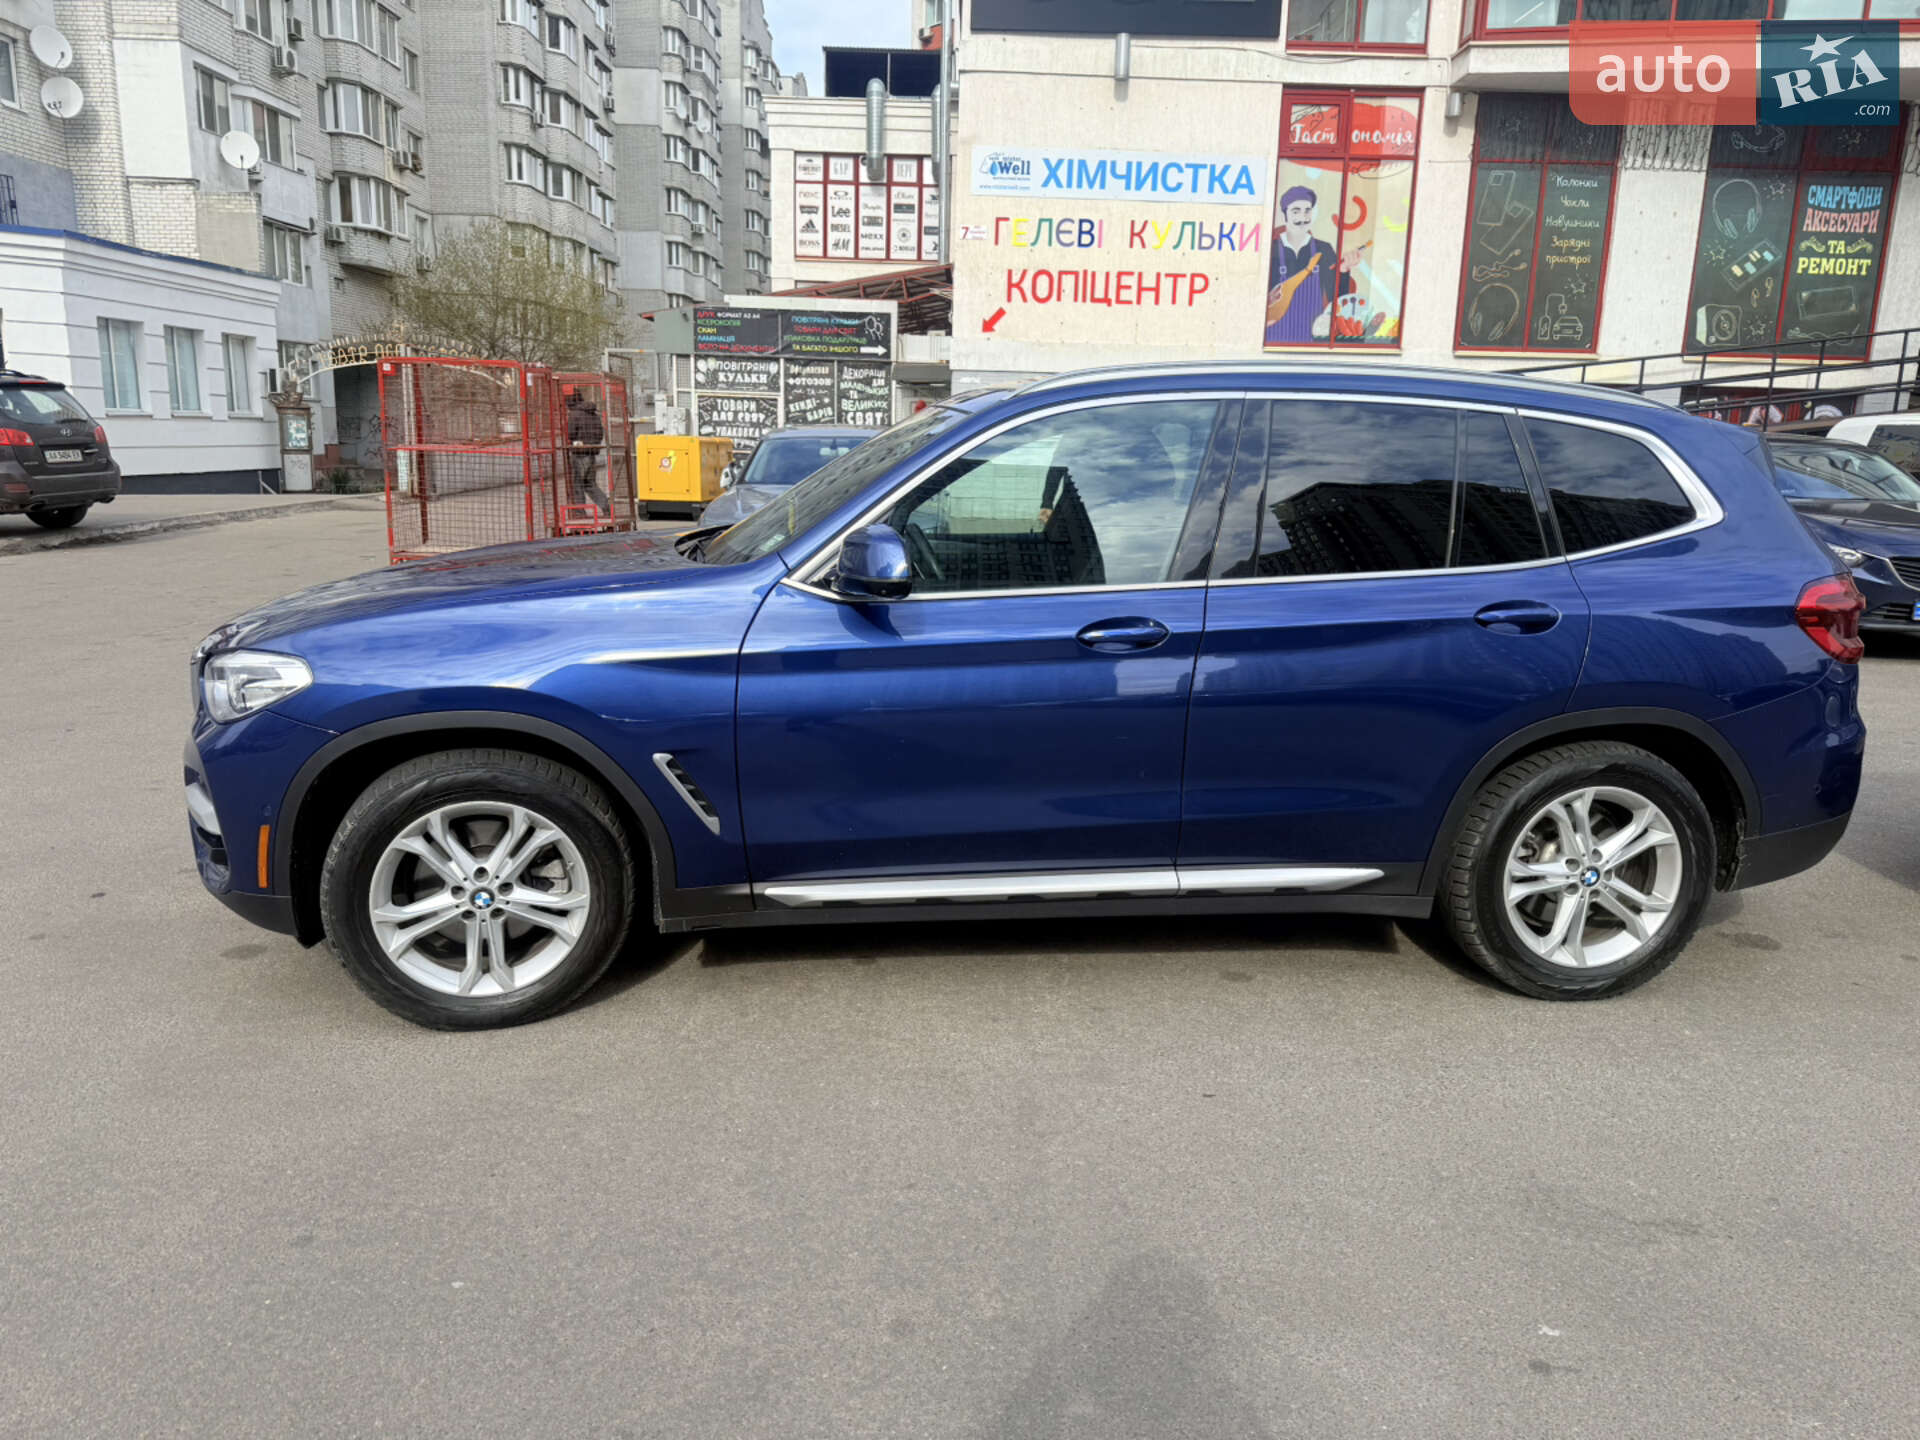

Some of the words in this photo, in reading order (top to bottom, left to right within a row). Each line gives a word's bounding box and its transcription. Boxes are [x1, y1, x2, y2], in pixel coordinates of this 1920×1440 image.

[998, 160, 1030, 175] Well
[1041, 158, 1255, 196] ХІМЧИСТКА
[1807, 185, 1883, 209] СМАРТФОНИ
[831, 206, 850, 218] Lee
[1802, 208, 1881, 233] АКСЕСУАРИ
[1545, 215, 1600, 232] Навушники
[994, 217, 1103, 248] ГЕЛЄВІ
[1129, 219, 1260, 252] КУЛЬКИ
[1827, 240, 1846, 254] ТА
[1796, 257, 1872, 276] РЕМОНТ
[1006, 269, 1209, 307] КОПІЦЕНТР
